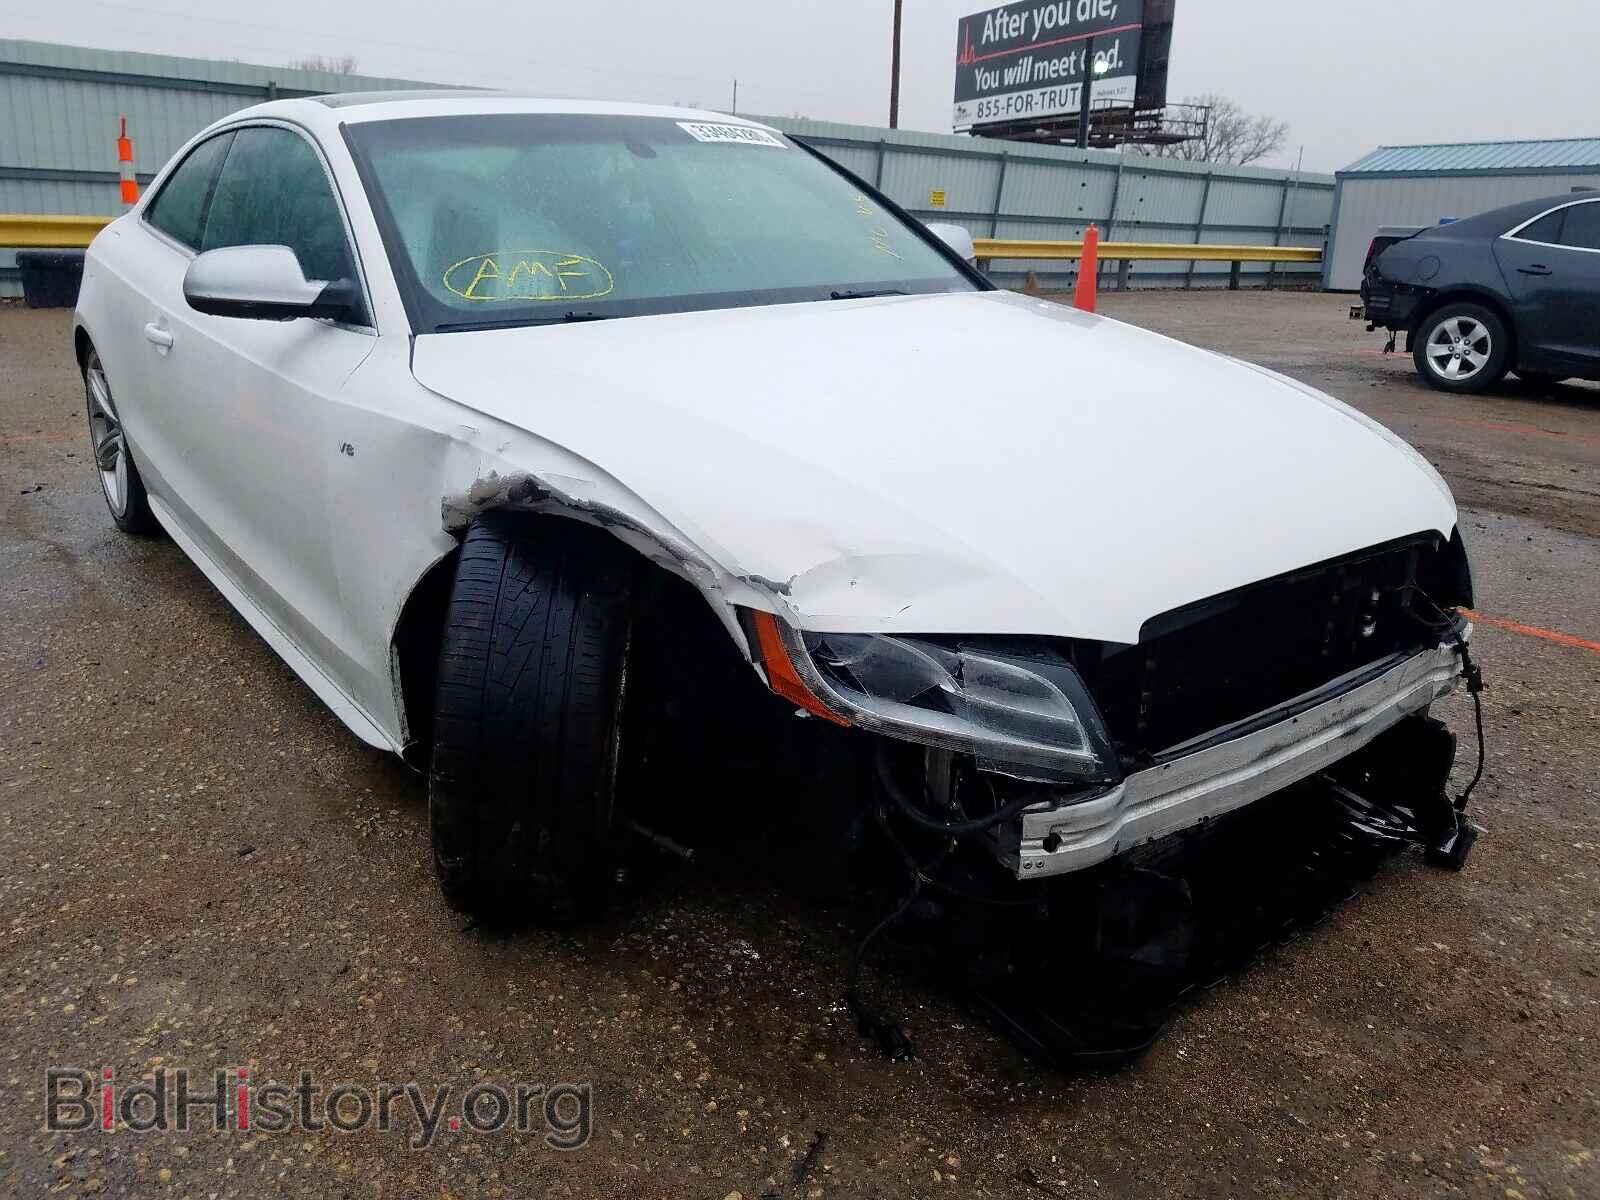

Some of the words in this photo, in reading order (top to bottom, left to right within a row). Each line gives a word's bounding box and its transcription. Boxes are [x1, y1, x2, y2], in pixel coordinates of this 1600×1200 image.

[981, 8, 1029, 45] After
[1032, 0, 1071, 41] you
[974, 67, 999, 92] You
[1004, 56, 1033, 86] will
[1034, 51, 1076, 81] meet
[1081, 39, 1123, 73] od.
[977, 87, 1083, 119] 855-FOR-TRUT
